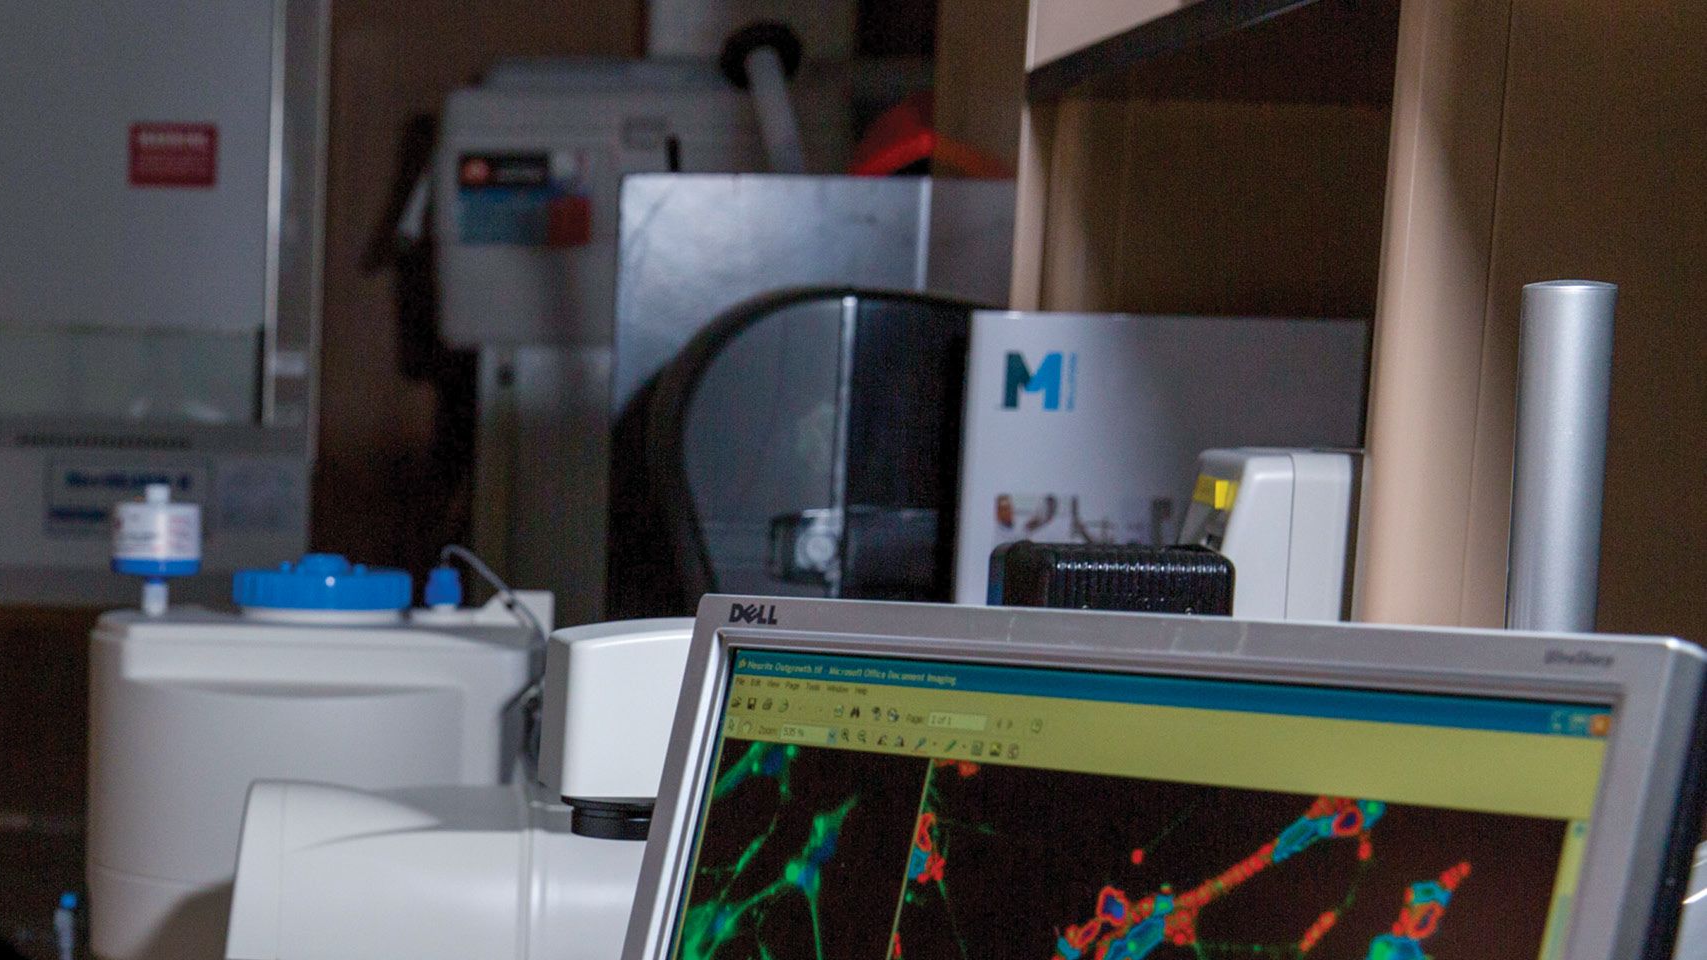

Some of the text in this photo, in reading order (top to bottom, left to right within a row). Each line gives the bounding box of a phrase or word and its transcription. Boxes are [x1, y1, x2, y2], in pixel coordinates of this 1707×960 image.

[1003, 351, 1063, 411] M
[728, 602, 778, 625] DELL
[864, 667, 886, 680] Office
[888, 669, 925, 682] Document
